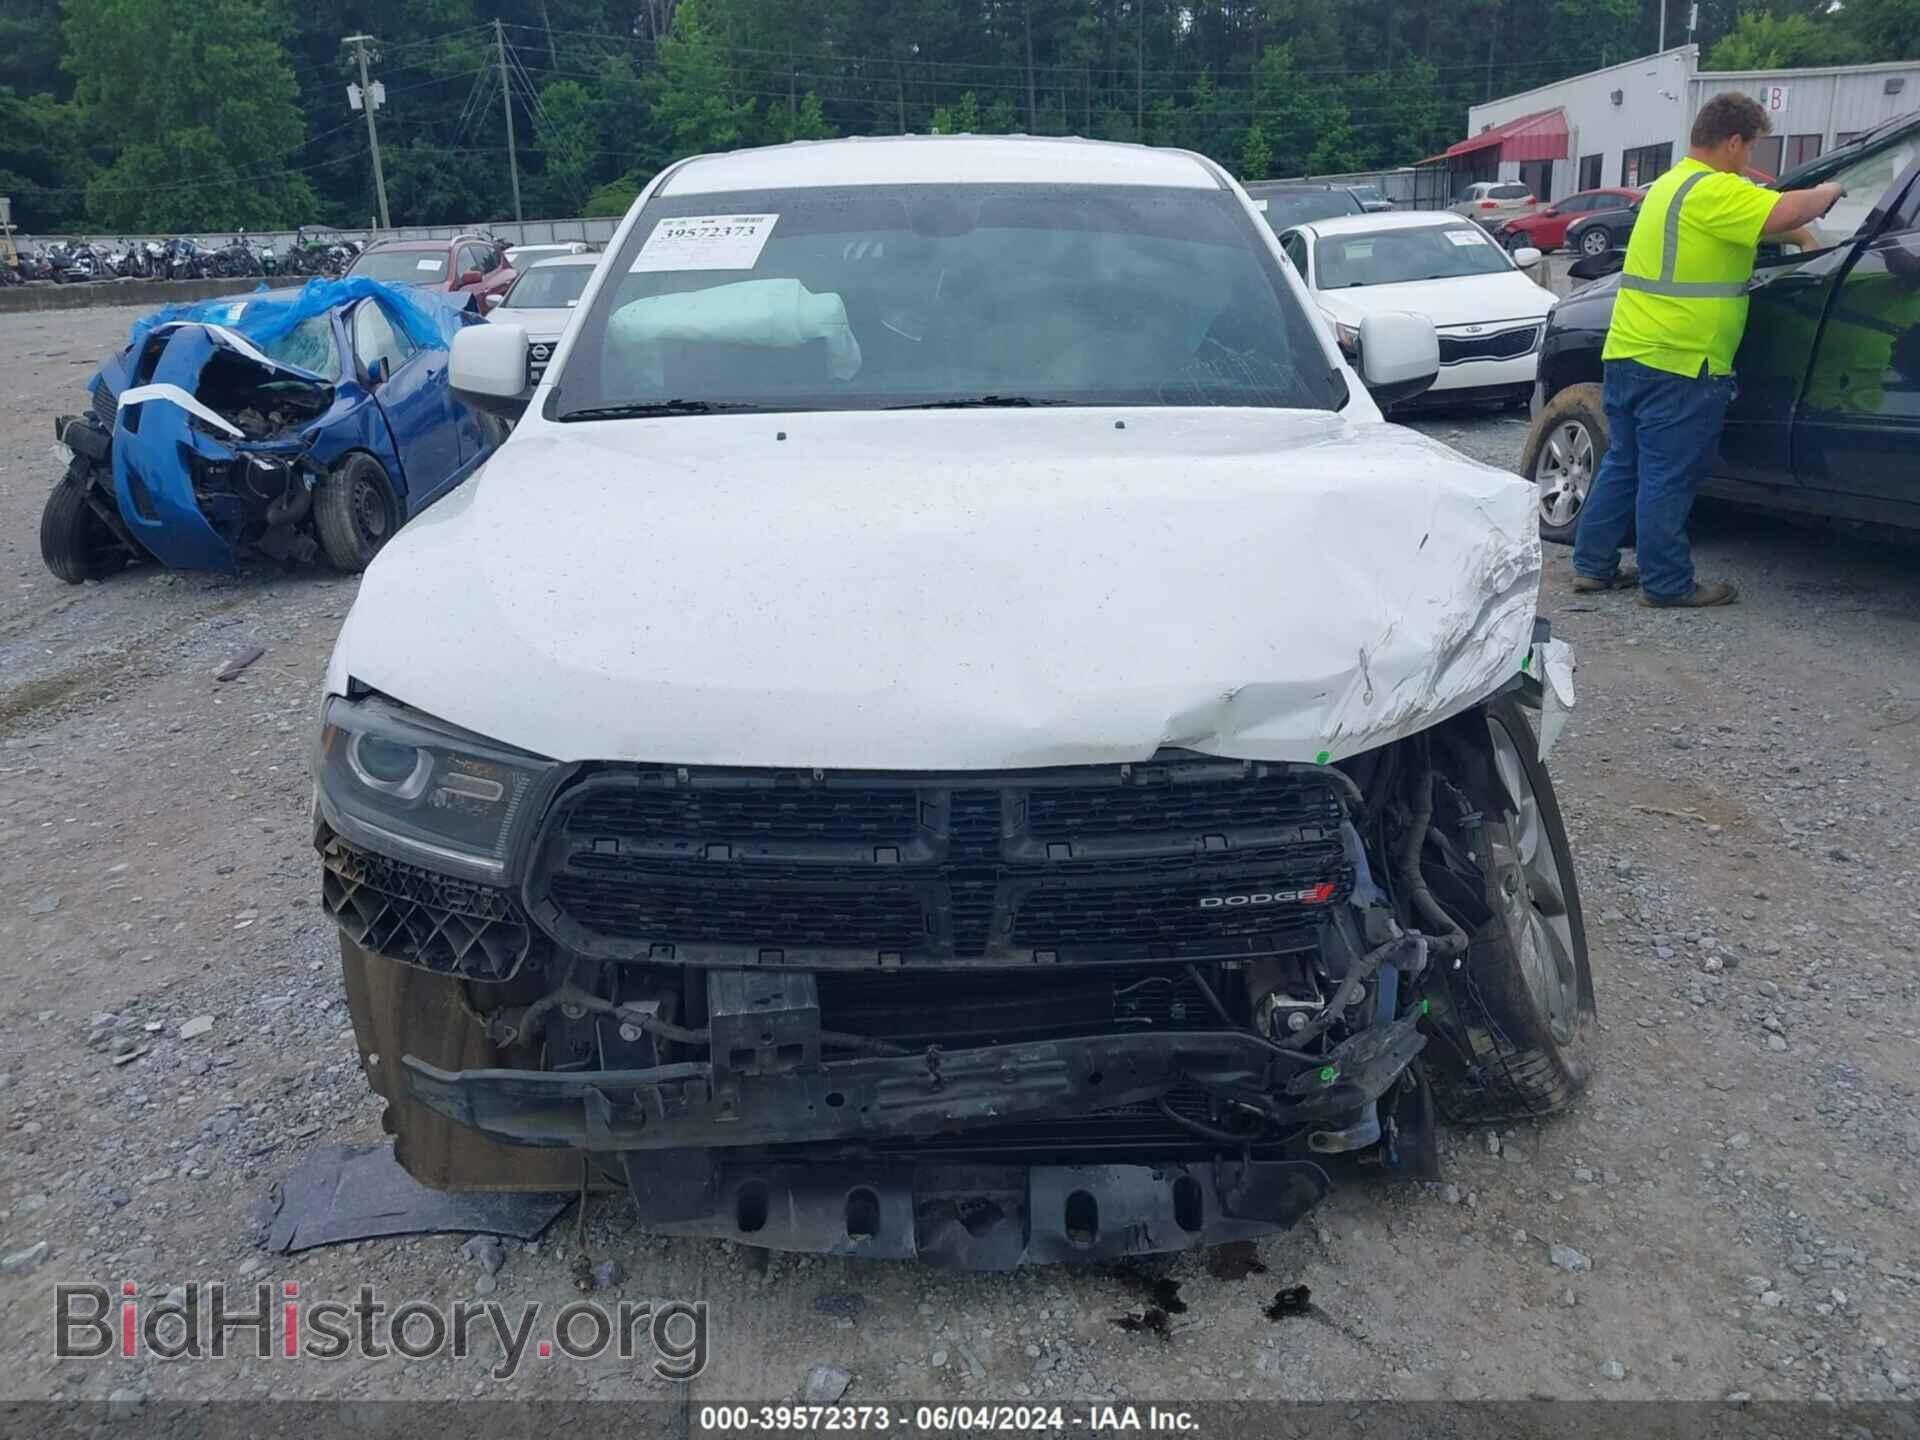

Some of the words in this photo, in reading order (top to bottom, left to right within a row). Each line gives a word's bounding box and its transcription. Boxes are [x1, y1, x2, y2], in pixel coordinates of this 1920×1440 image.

[1771, 87, 1782, 110] B
[660, 225, 756, 240] 39572373
[1200, 889, 1318, 908] DODGE
